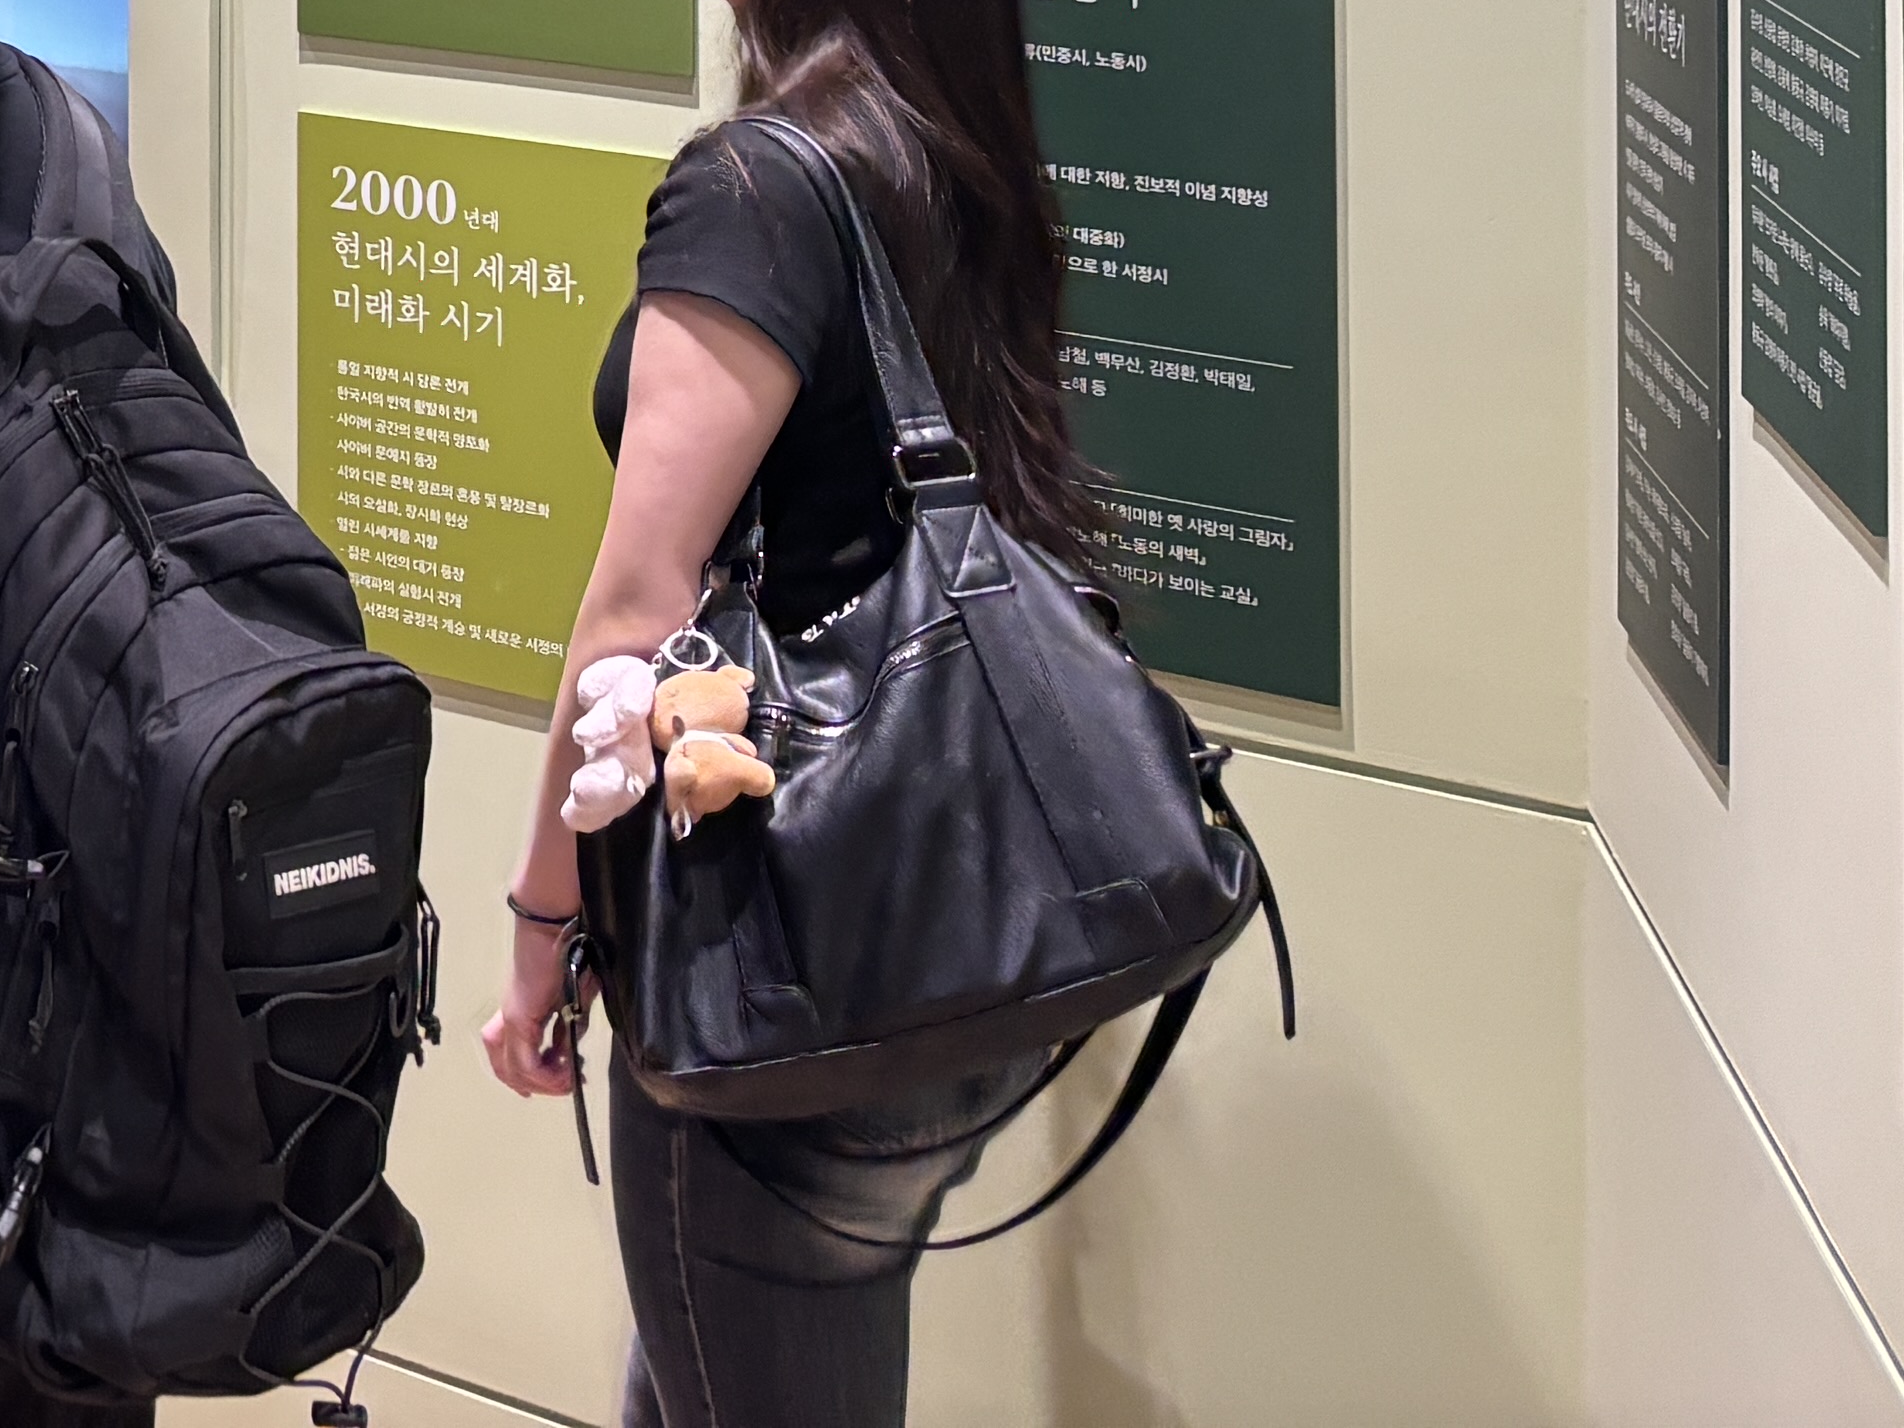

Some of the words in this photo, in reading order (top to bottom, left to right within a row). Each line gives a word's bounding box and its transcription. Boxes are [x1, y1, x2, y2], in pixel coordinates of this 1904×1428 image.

[330, 165, 457, 225] 2000
[464, 208, 499, 232] 년대
[1061, 169, 1091, 184] 대한
[1096, 170, 1129, 191] 저항,
[1135, 176, 1180, 196] 진보적
[1185, 181, 1215, 201] 이념
[1221, 186, 1268, 208] 지향성
[1073, 227, 1125, 249] 대중화)
[332, 232, 459, 286] 현대시의
[474, 252, 584, 304] 세계화,
[1102, 260, 1117, 278] 한
[1122, 262, 1168, 285] 서정시
[333, 284, 430, 333] 미래화
[441, 301, 503, 347] 시기
[1092, 379, 1107, 397] 등
[273, 853, 376, 896] NEIKIDNIS.
